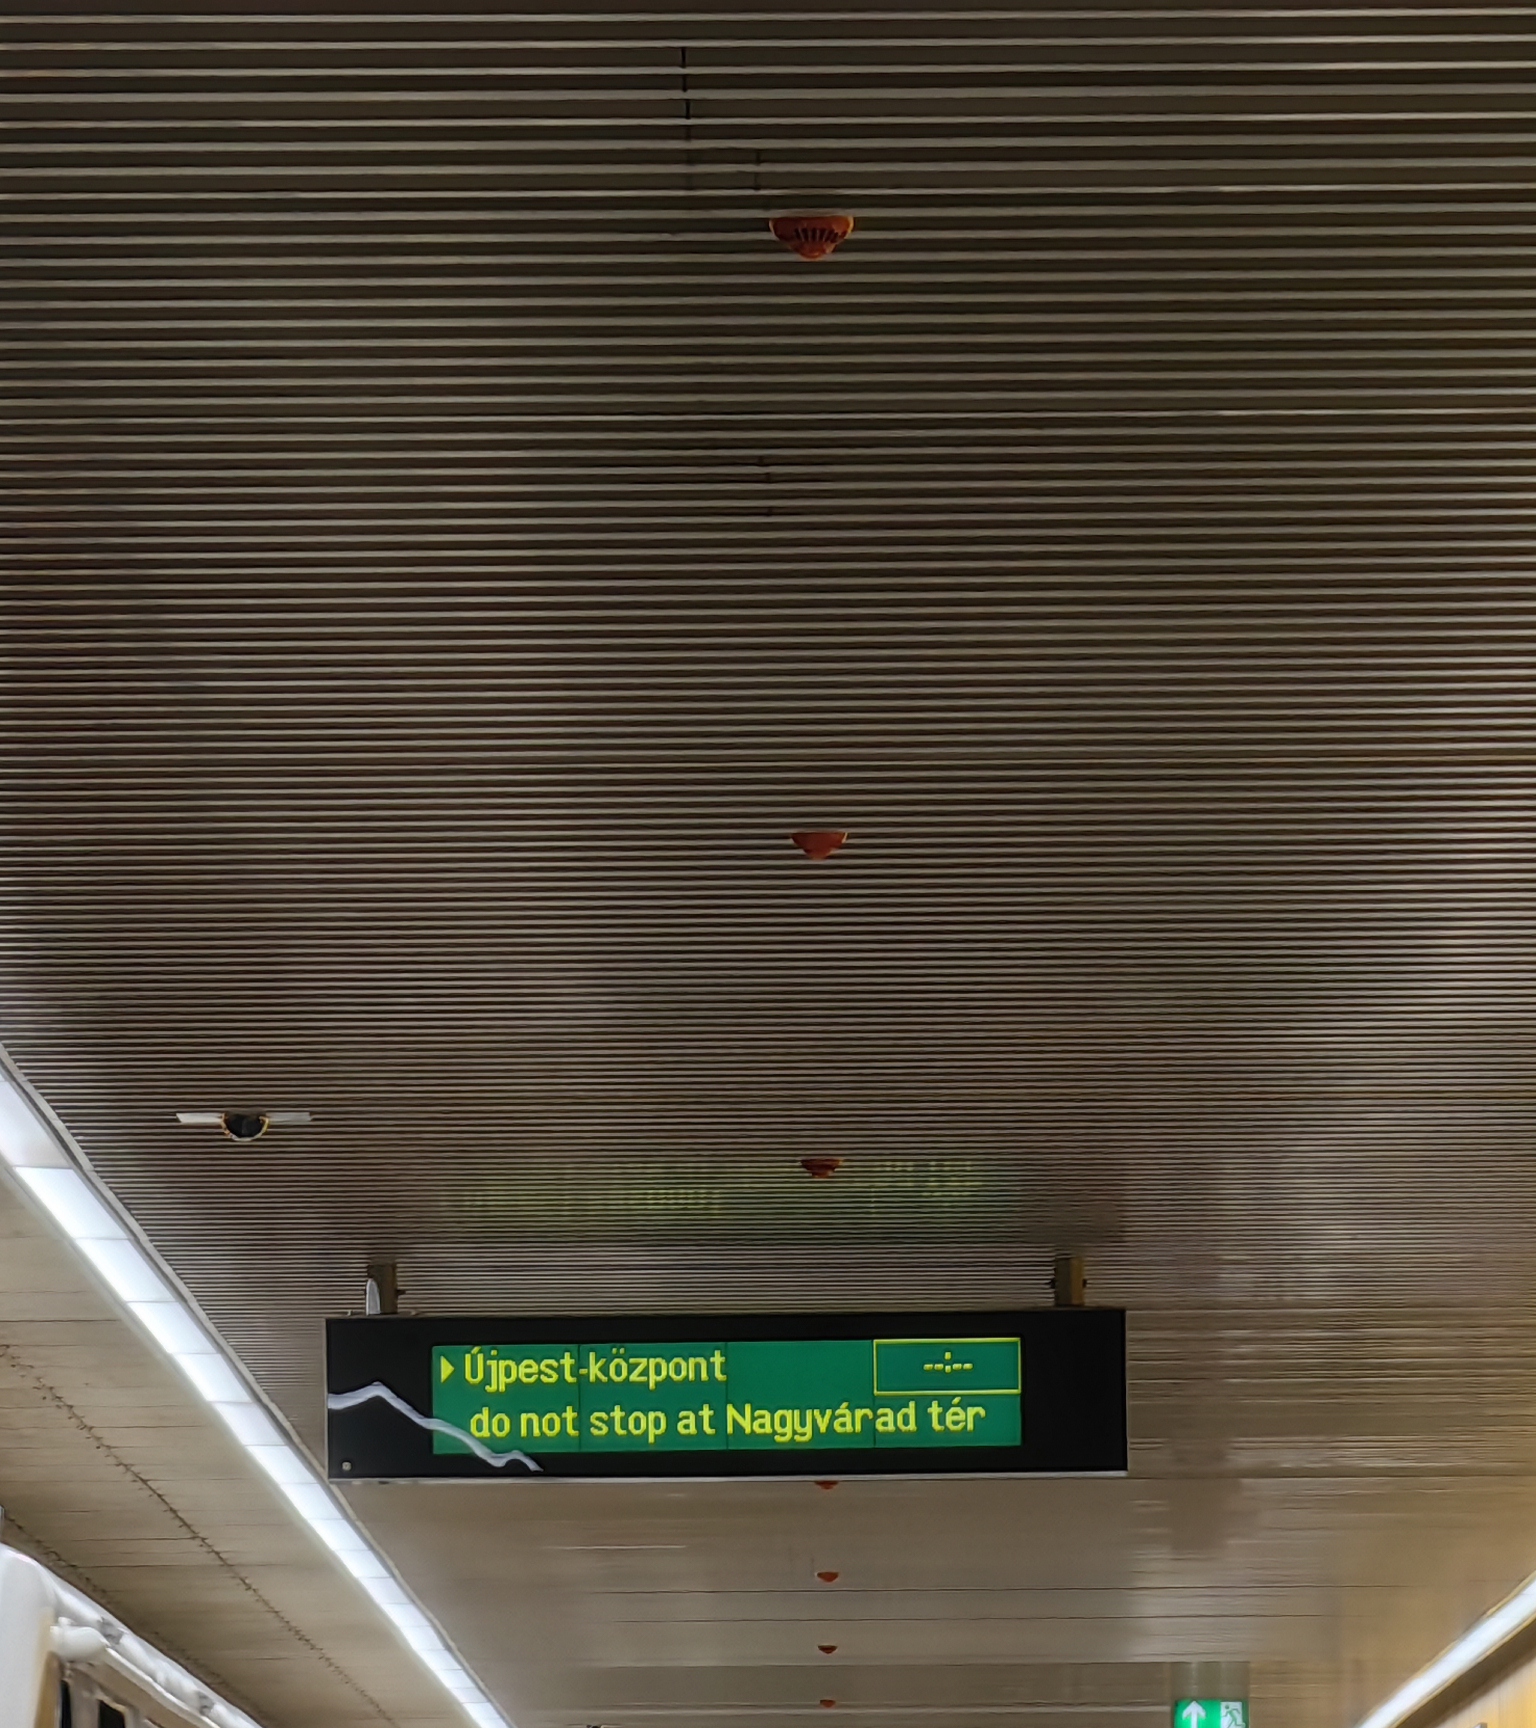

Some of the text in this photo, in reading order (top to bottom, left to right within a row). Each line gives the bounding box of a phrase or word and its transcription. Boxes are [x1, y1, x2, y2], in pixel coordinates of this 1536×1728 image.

[464, 1346, 727, 1393] Újpest-központ
[470, 1396, 986, 1444] do not stop at Nagyvárad tér
